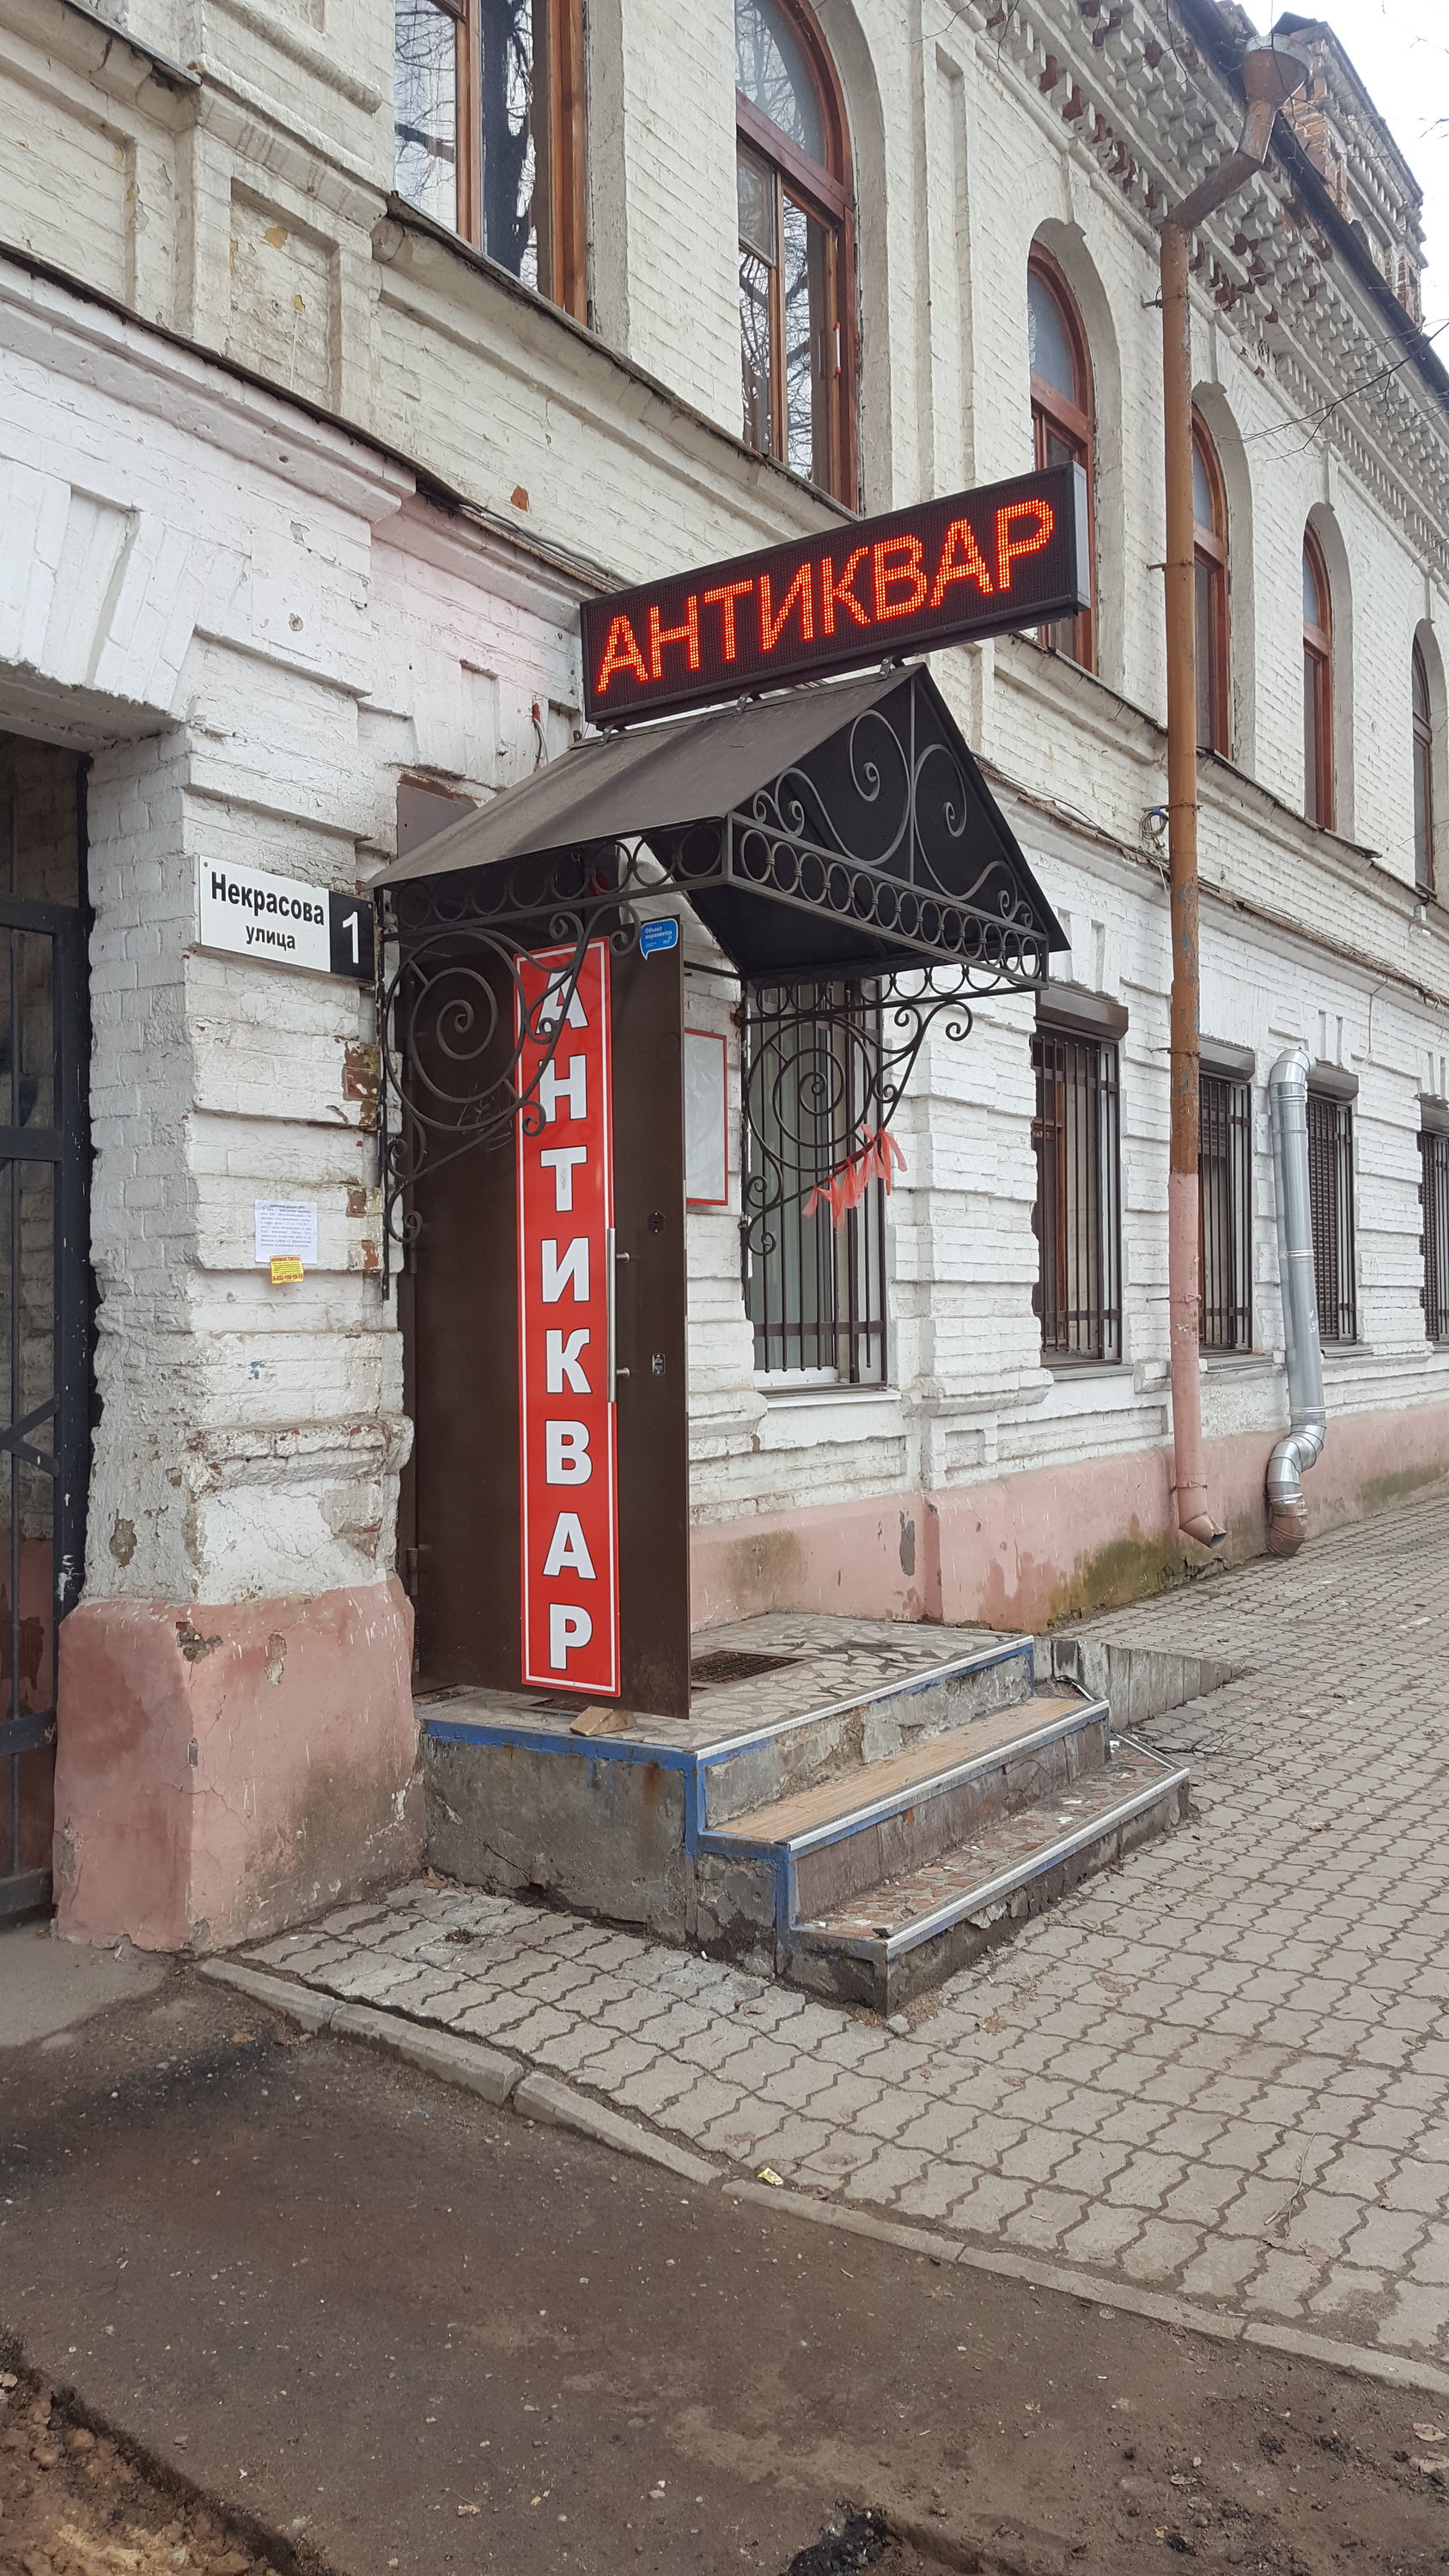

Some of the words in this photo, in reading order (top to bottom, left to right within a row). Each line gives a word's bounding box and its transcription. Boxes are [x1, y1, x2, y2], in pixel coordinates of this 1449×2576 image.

[597, 498, 1055, 692] АНТИКВАР
[211, 871, 325, 926] Некрасова
[246, 925, 296, 951] улица
[343, 911, 360, 964] 1
[535, 970, 598, 1670] АНТИКВАР
